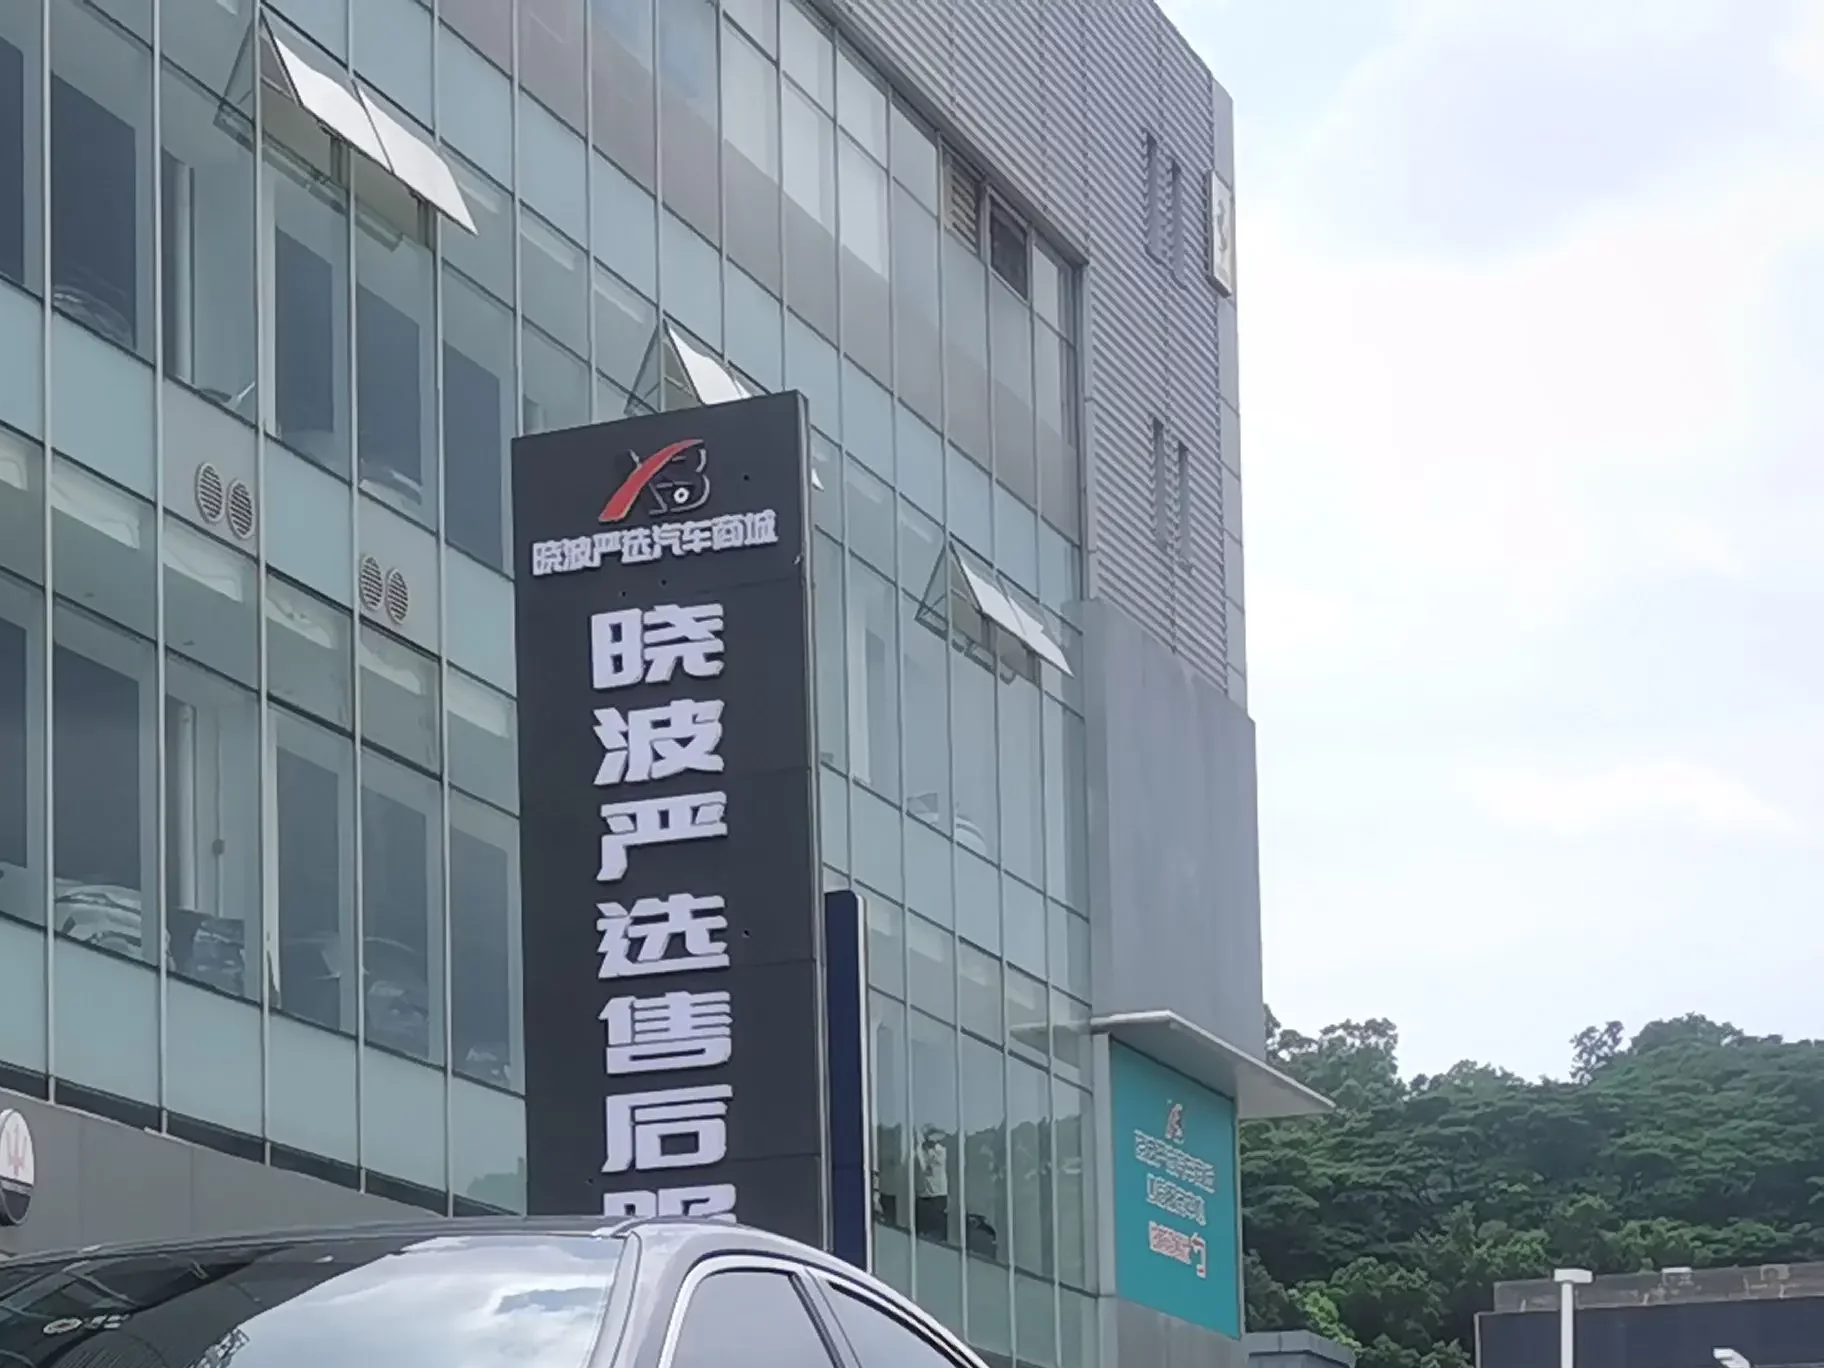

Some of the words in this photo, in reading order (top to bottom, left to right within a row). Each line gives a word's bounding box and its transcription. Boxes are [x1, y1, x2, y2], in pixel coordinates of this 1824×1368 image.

[531, 509, 779, 577] 晓波严选汽车商城
